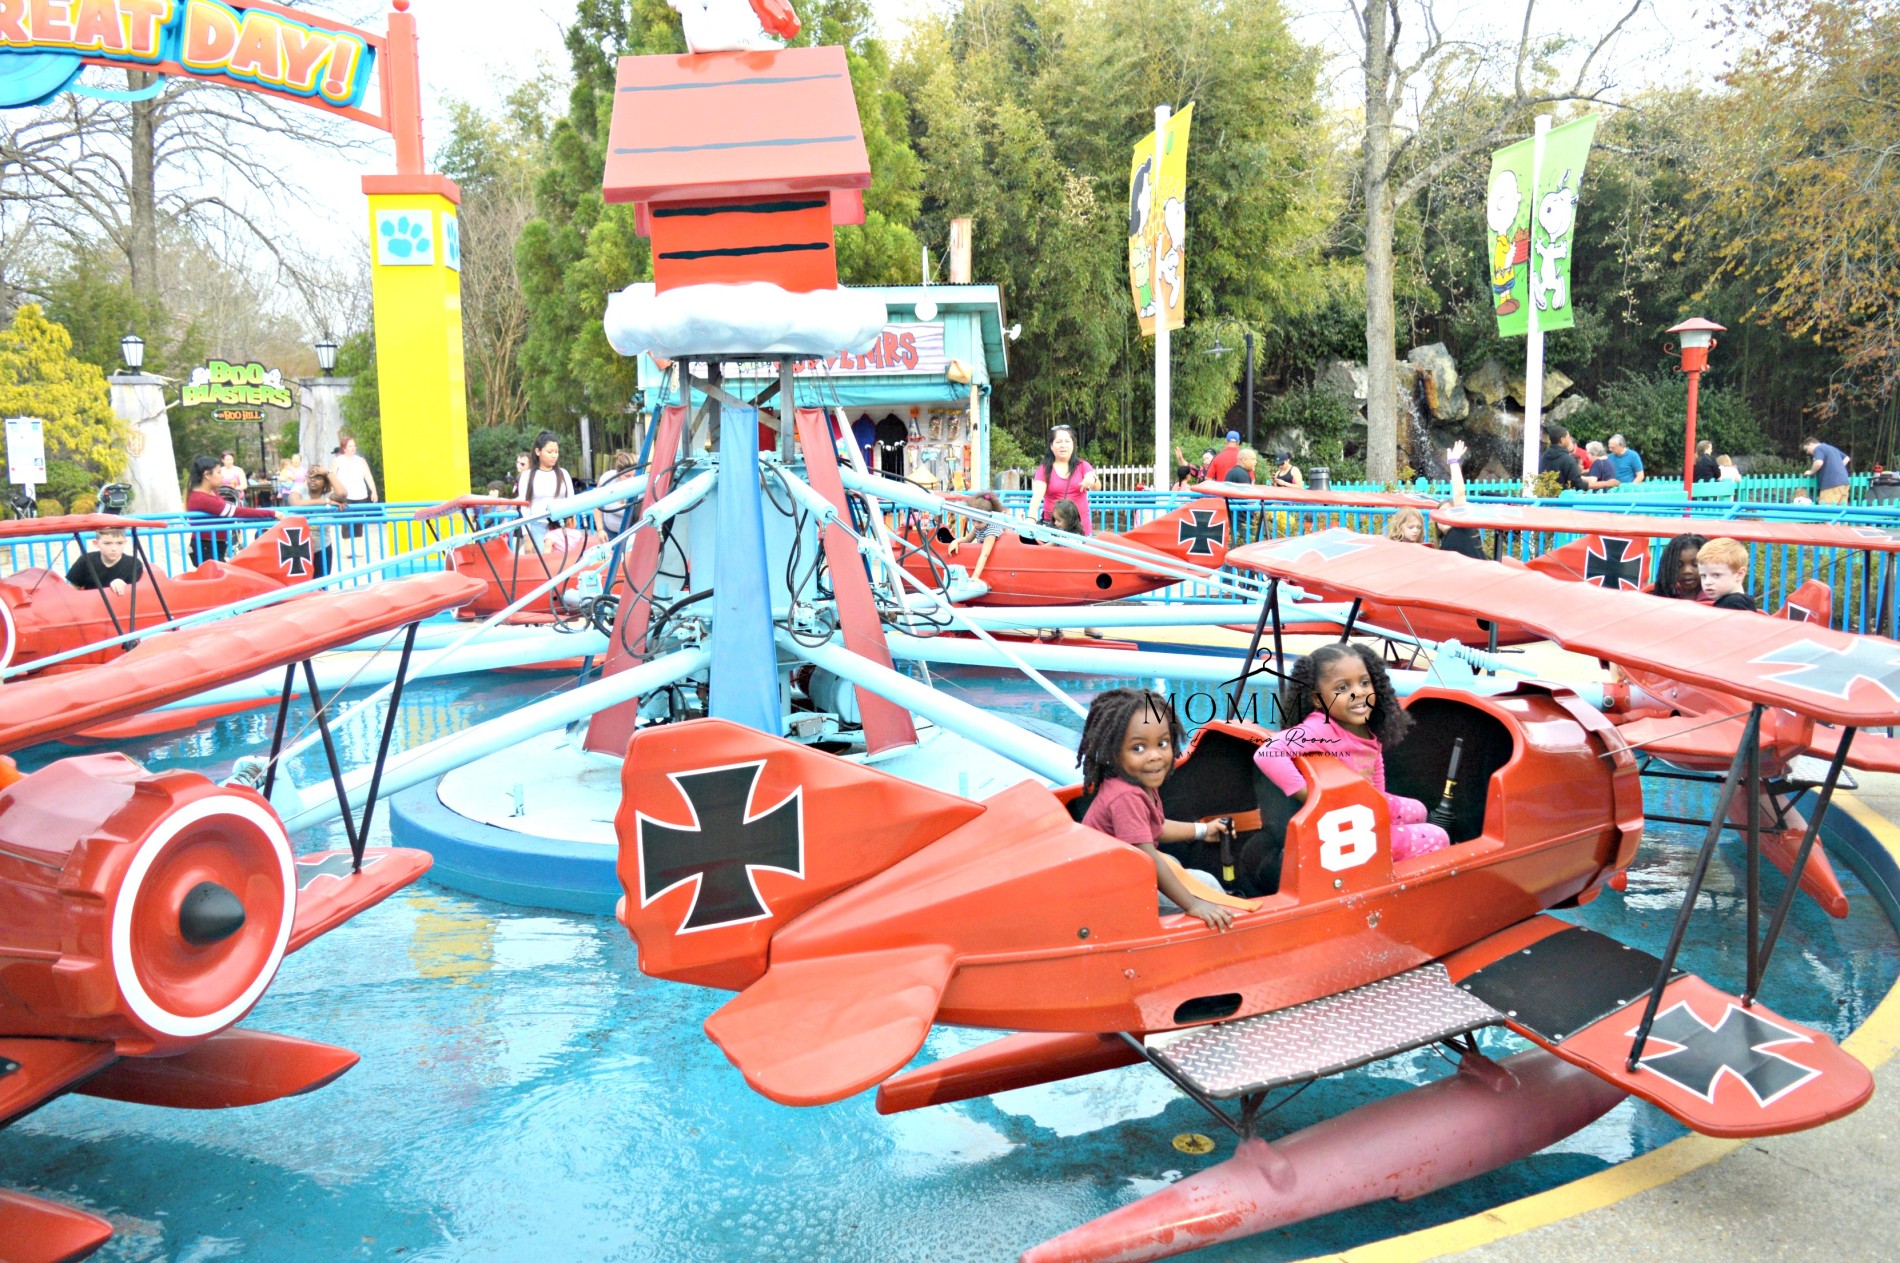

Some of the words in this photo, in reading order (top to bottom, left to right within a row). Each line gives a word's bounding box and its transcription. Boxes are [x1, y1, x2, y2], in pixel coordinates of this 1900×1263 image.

[186, 3, 353, 96] DAY!
[182, 384, 292, 408] BLASTERS
[224, 410, 242, 420] BOO
[242, 410, 261, 420] HILL
[1317, 804, 1377, 872] 8
